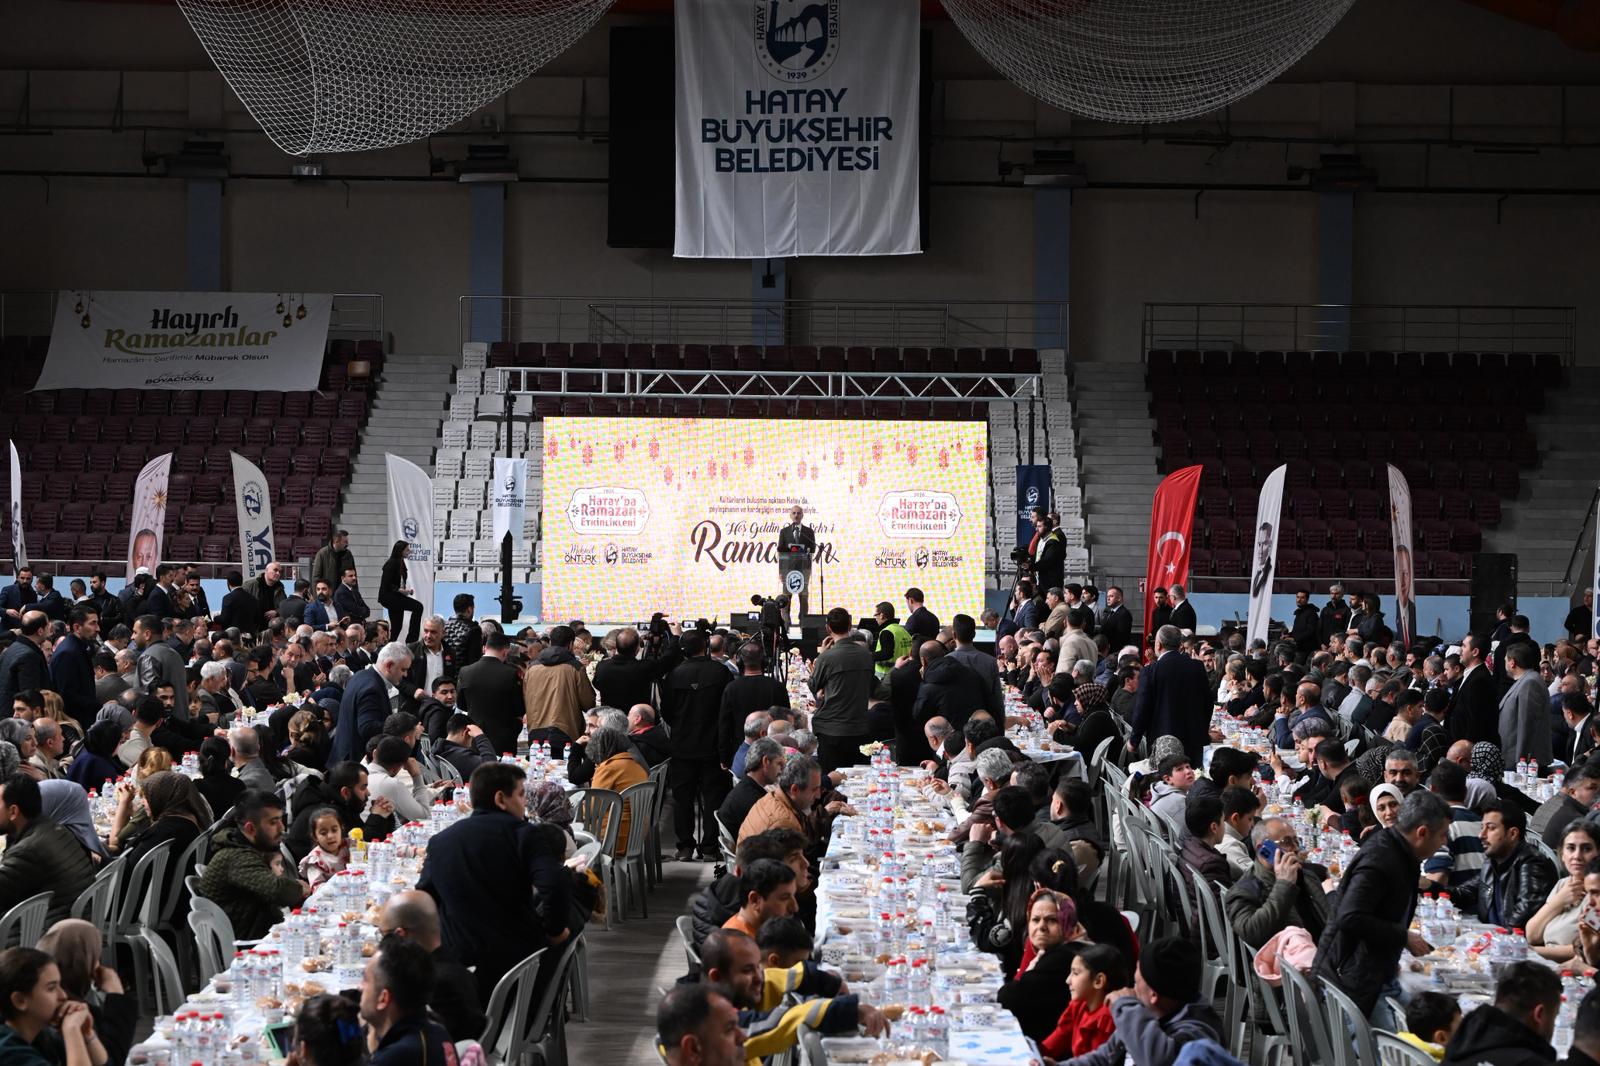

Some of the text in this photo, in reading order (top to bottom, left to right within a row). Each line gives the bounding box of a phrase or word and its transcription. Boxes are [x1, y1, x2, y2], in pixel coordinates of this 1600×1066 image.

[756, 6, 765, 40] HATAY
[746, 88, 848, 115] HATAY
[701, 116, 893, 144] BÜYÜKŞEHİR
[715, 146, 879, 173] BELEDİYESİ
[149, 305, 239, 336] Hayırlı
[104, 325, 278, 355] Ramazanlar
[242, 353, 269, 361] Olsun
[749, 521, 780, 539] Geldin
[690, 519, 838, 572] Raman
